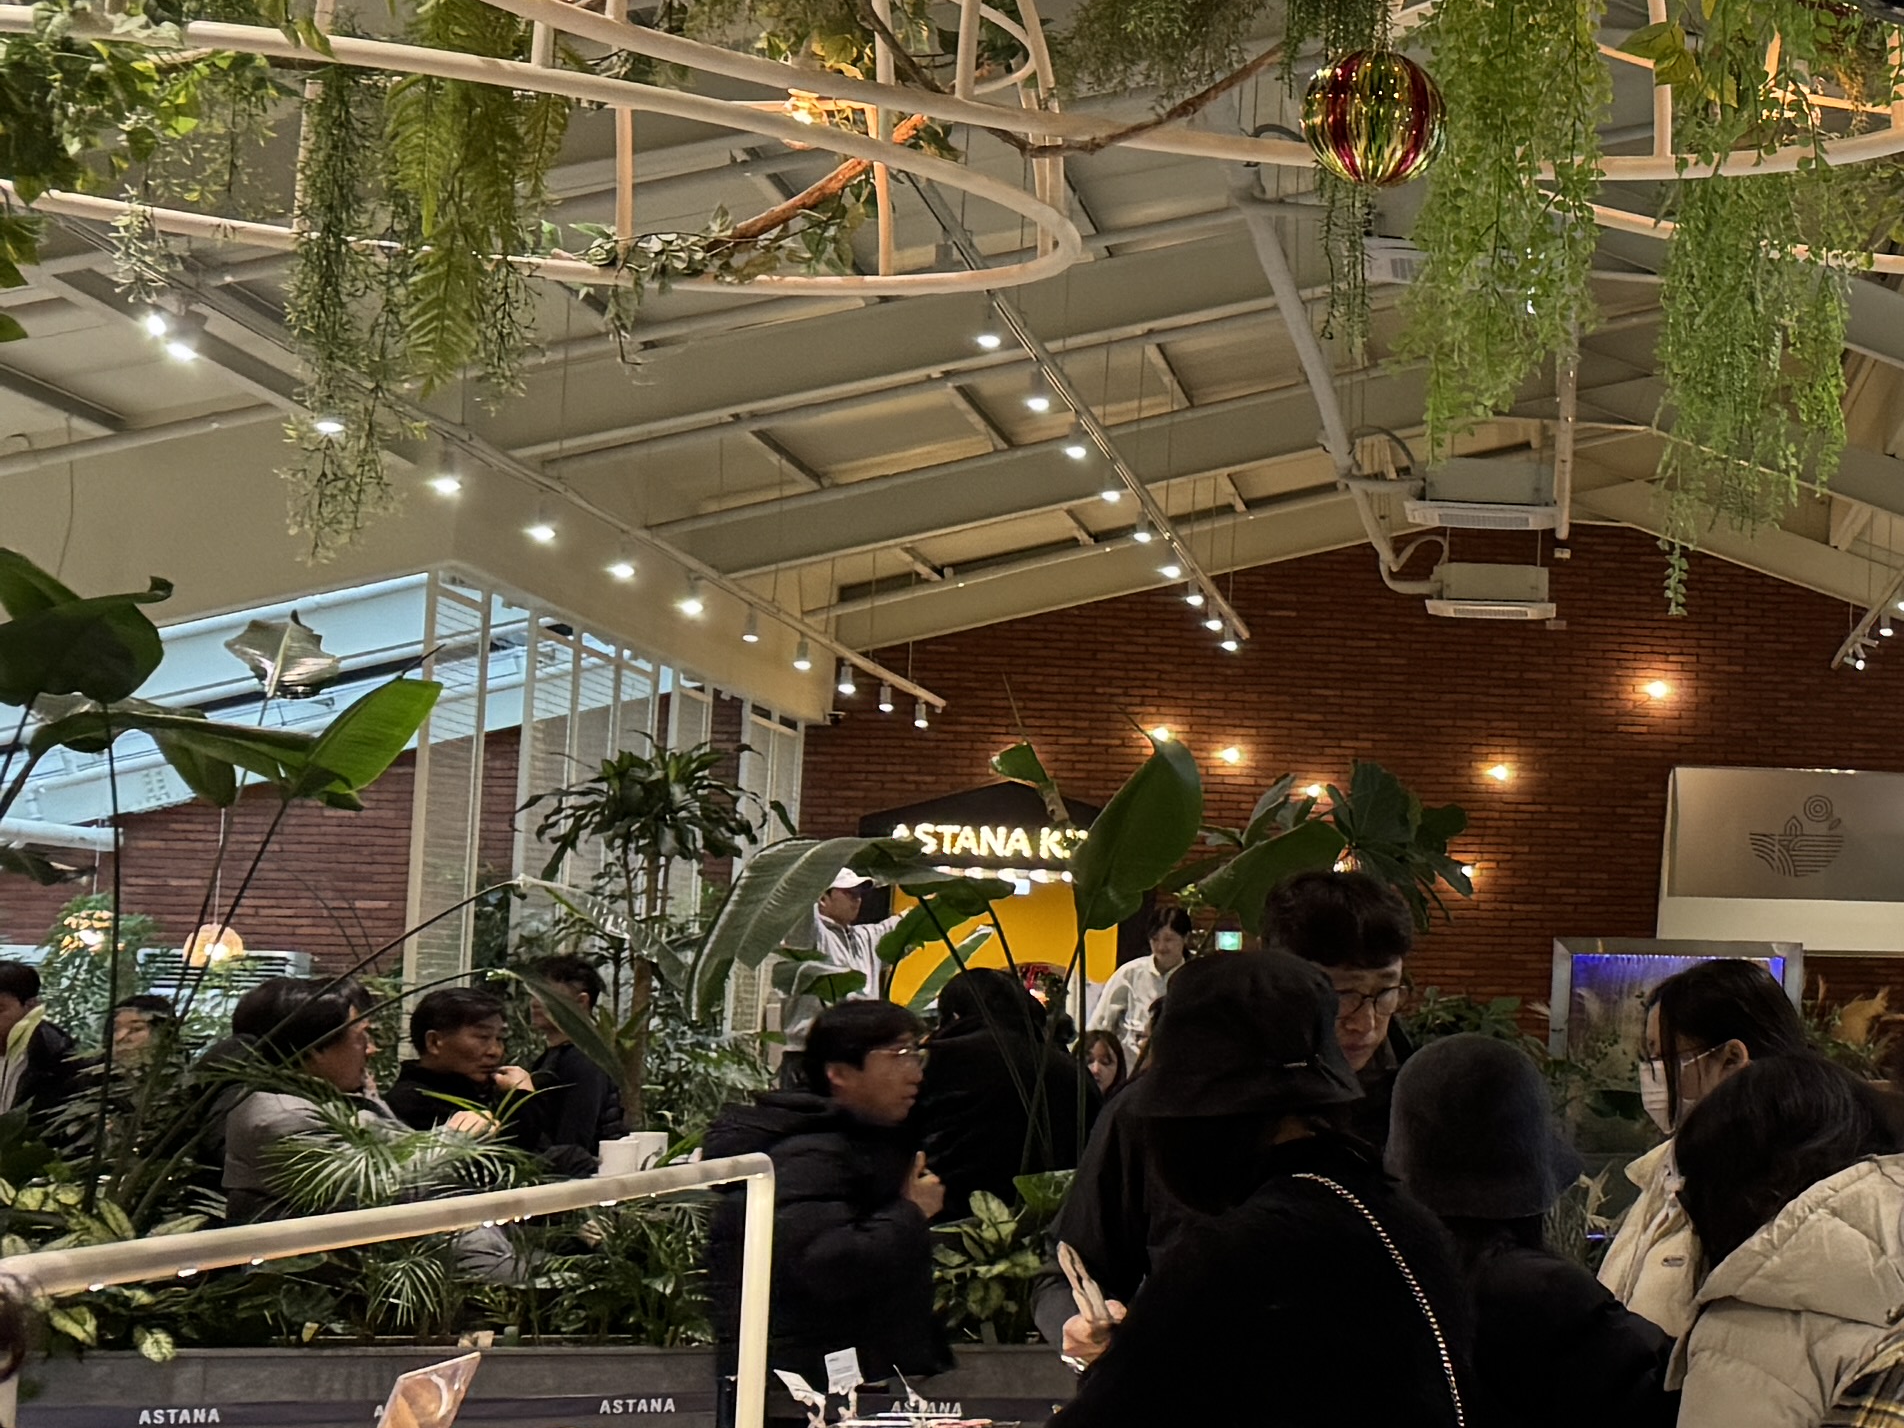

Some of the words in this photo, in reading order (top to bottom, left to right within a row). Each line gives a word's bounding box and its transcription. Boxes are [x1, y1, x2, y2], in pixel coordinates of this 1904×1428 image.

[599, 1397, 676, 1415] ASTANA
[891, 1400, 962, 1414] AANA
[138, 1407, 221, 1426] ASTANA
